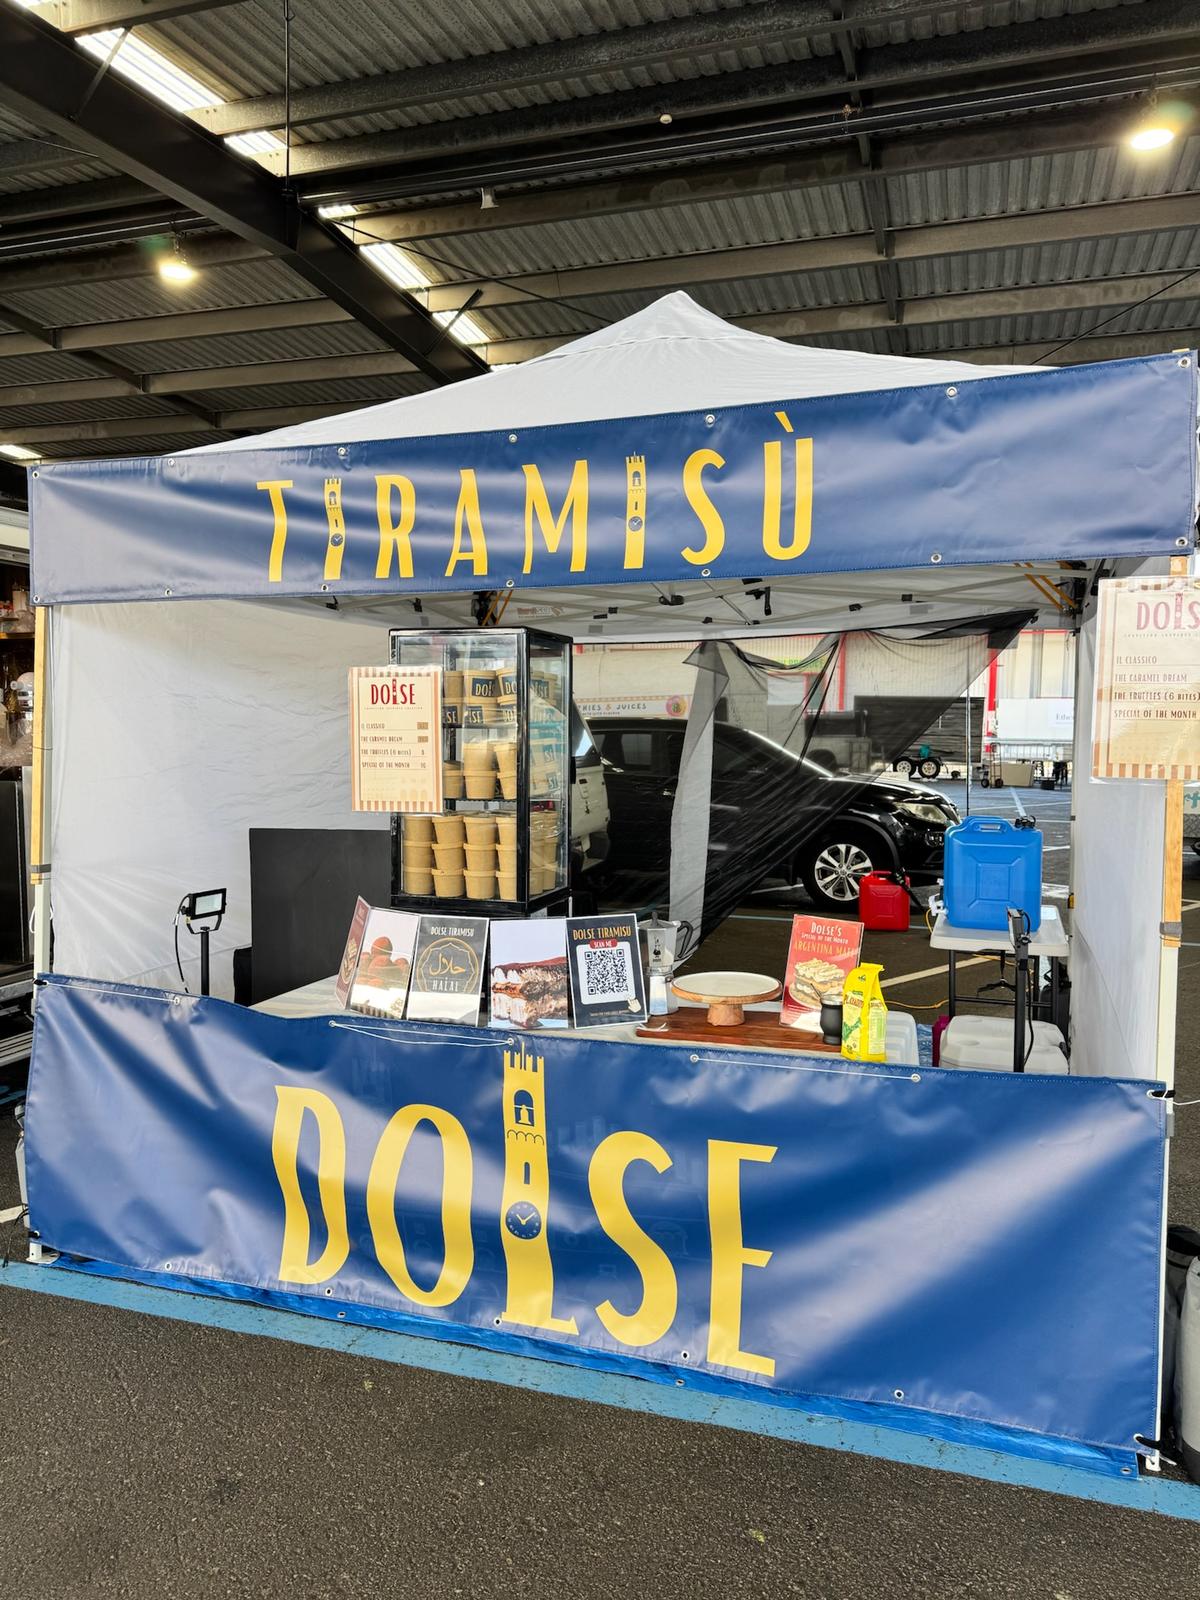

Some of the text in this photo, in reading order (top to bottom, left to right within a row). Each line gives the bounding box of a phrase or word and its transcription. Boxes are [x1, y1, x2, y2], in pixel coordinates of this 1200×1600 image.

[256, 411, 813, 582] TIRAMISÙ
[1116, 656, 1157, 664] IL CLASSICO
[1115, 674, 1187, 682] THE CARAMEL DREAM
[1114, 692, 1126, 700] THE
[1129, 692, 1161, 700] TRUFFLES
[616, 702, 647, 711] JUICES
[1113, 710, 1197, 719] SPECIAL OF THE MONTH
[430, 926, 474, 937] DOLSE TIRAMISU
[572, 926, 632, 940] DOLSE TIRAMISU
[795, 940, 833, 955] ARGENTINA
[429, 952, 465, 976] حلال
[432, 978, 459, 992] HALAL
